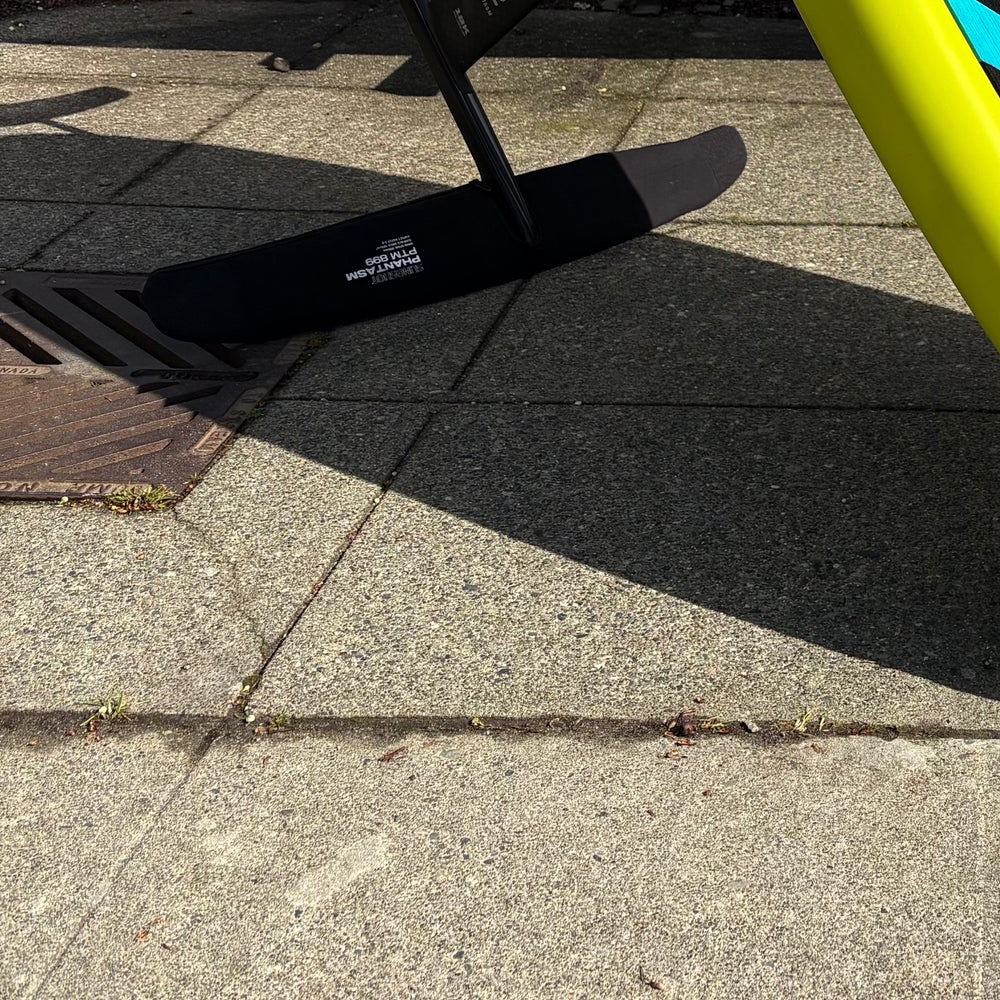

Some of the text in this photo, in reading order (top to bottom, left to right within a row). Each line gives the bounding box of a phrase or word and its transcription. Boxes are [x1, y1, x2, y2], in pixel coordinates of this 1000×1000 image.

[345, 254, 422, 281] PHANTASM
[365, 246, 418, 266] PTM 899
